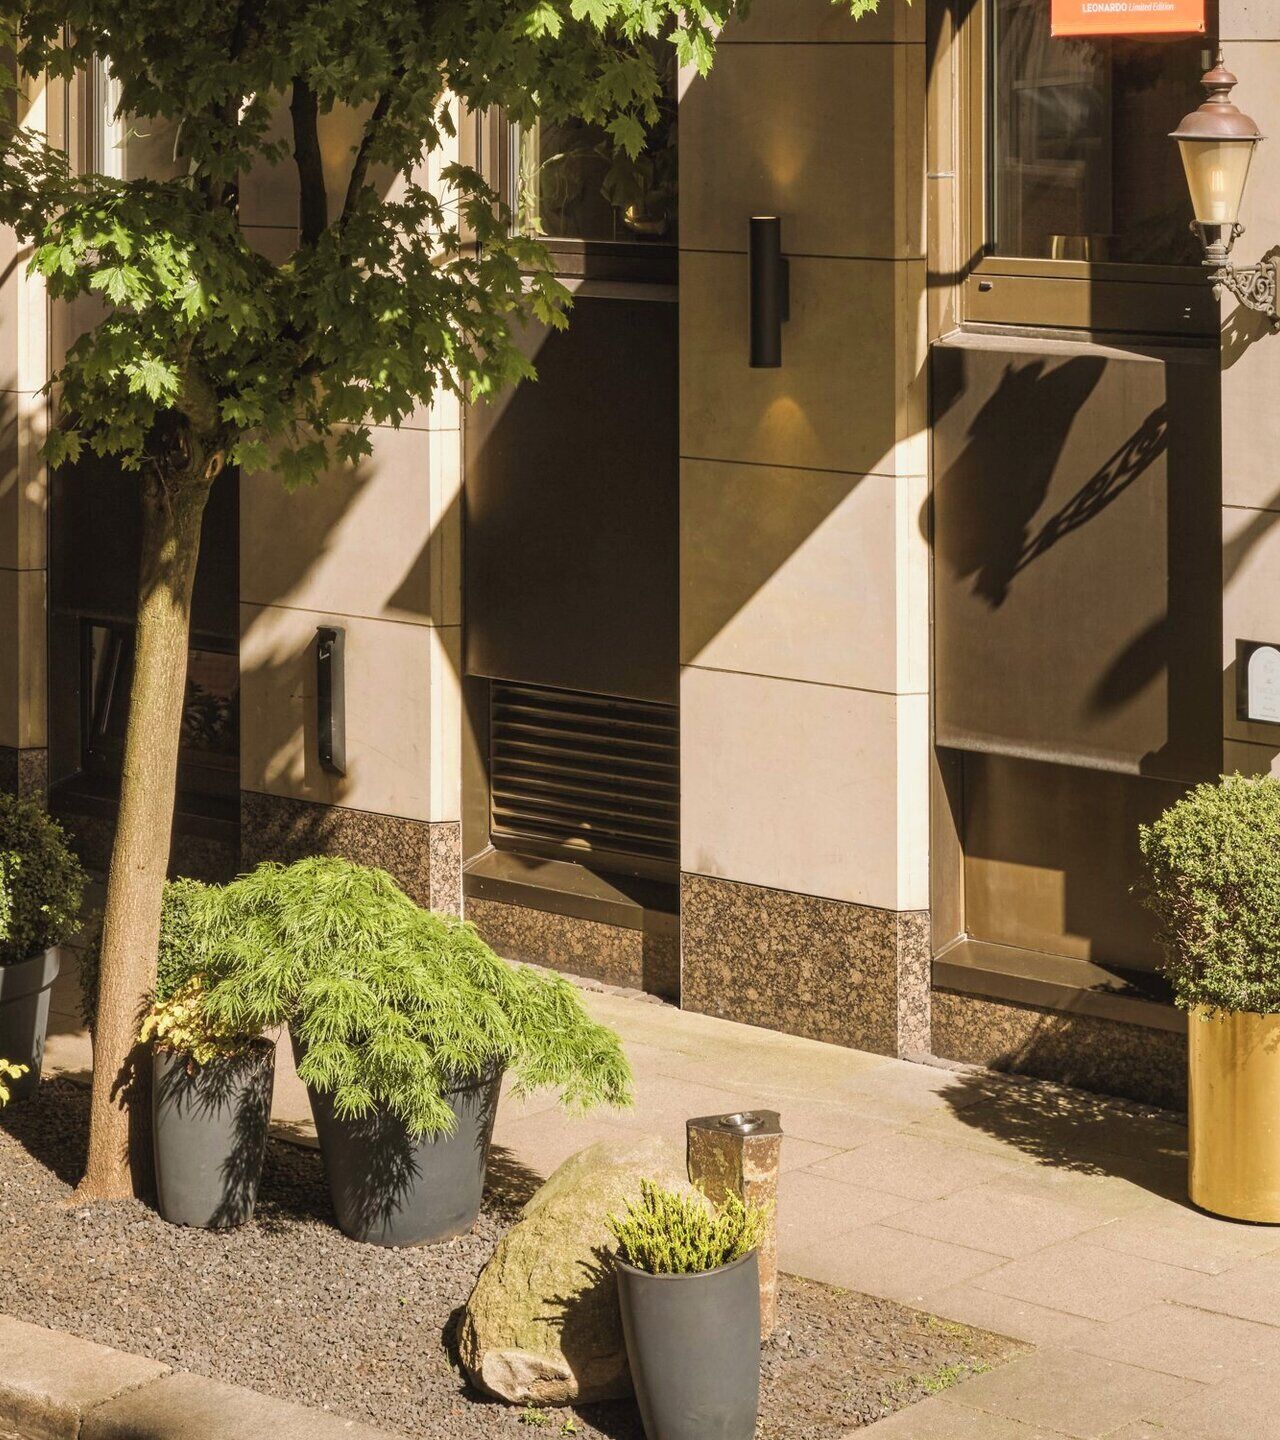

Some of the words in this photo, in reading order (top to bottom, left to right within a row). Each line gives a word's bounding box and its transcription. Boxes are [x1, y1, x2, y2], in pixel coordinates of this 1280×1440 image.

[1082, 2, 1127, 13] LEONARDO
[1129, 2, 1152, 12] Limited
[1152, 1, 1175, 11] Edition
